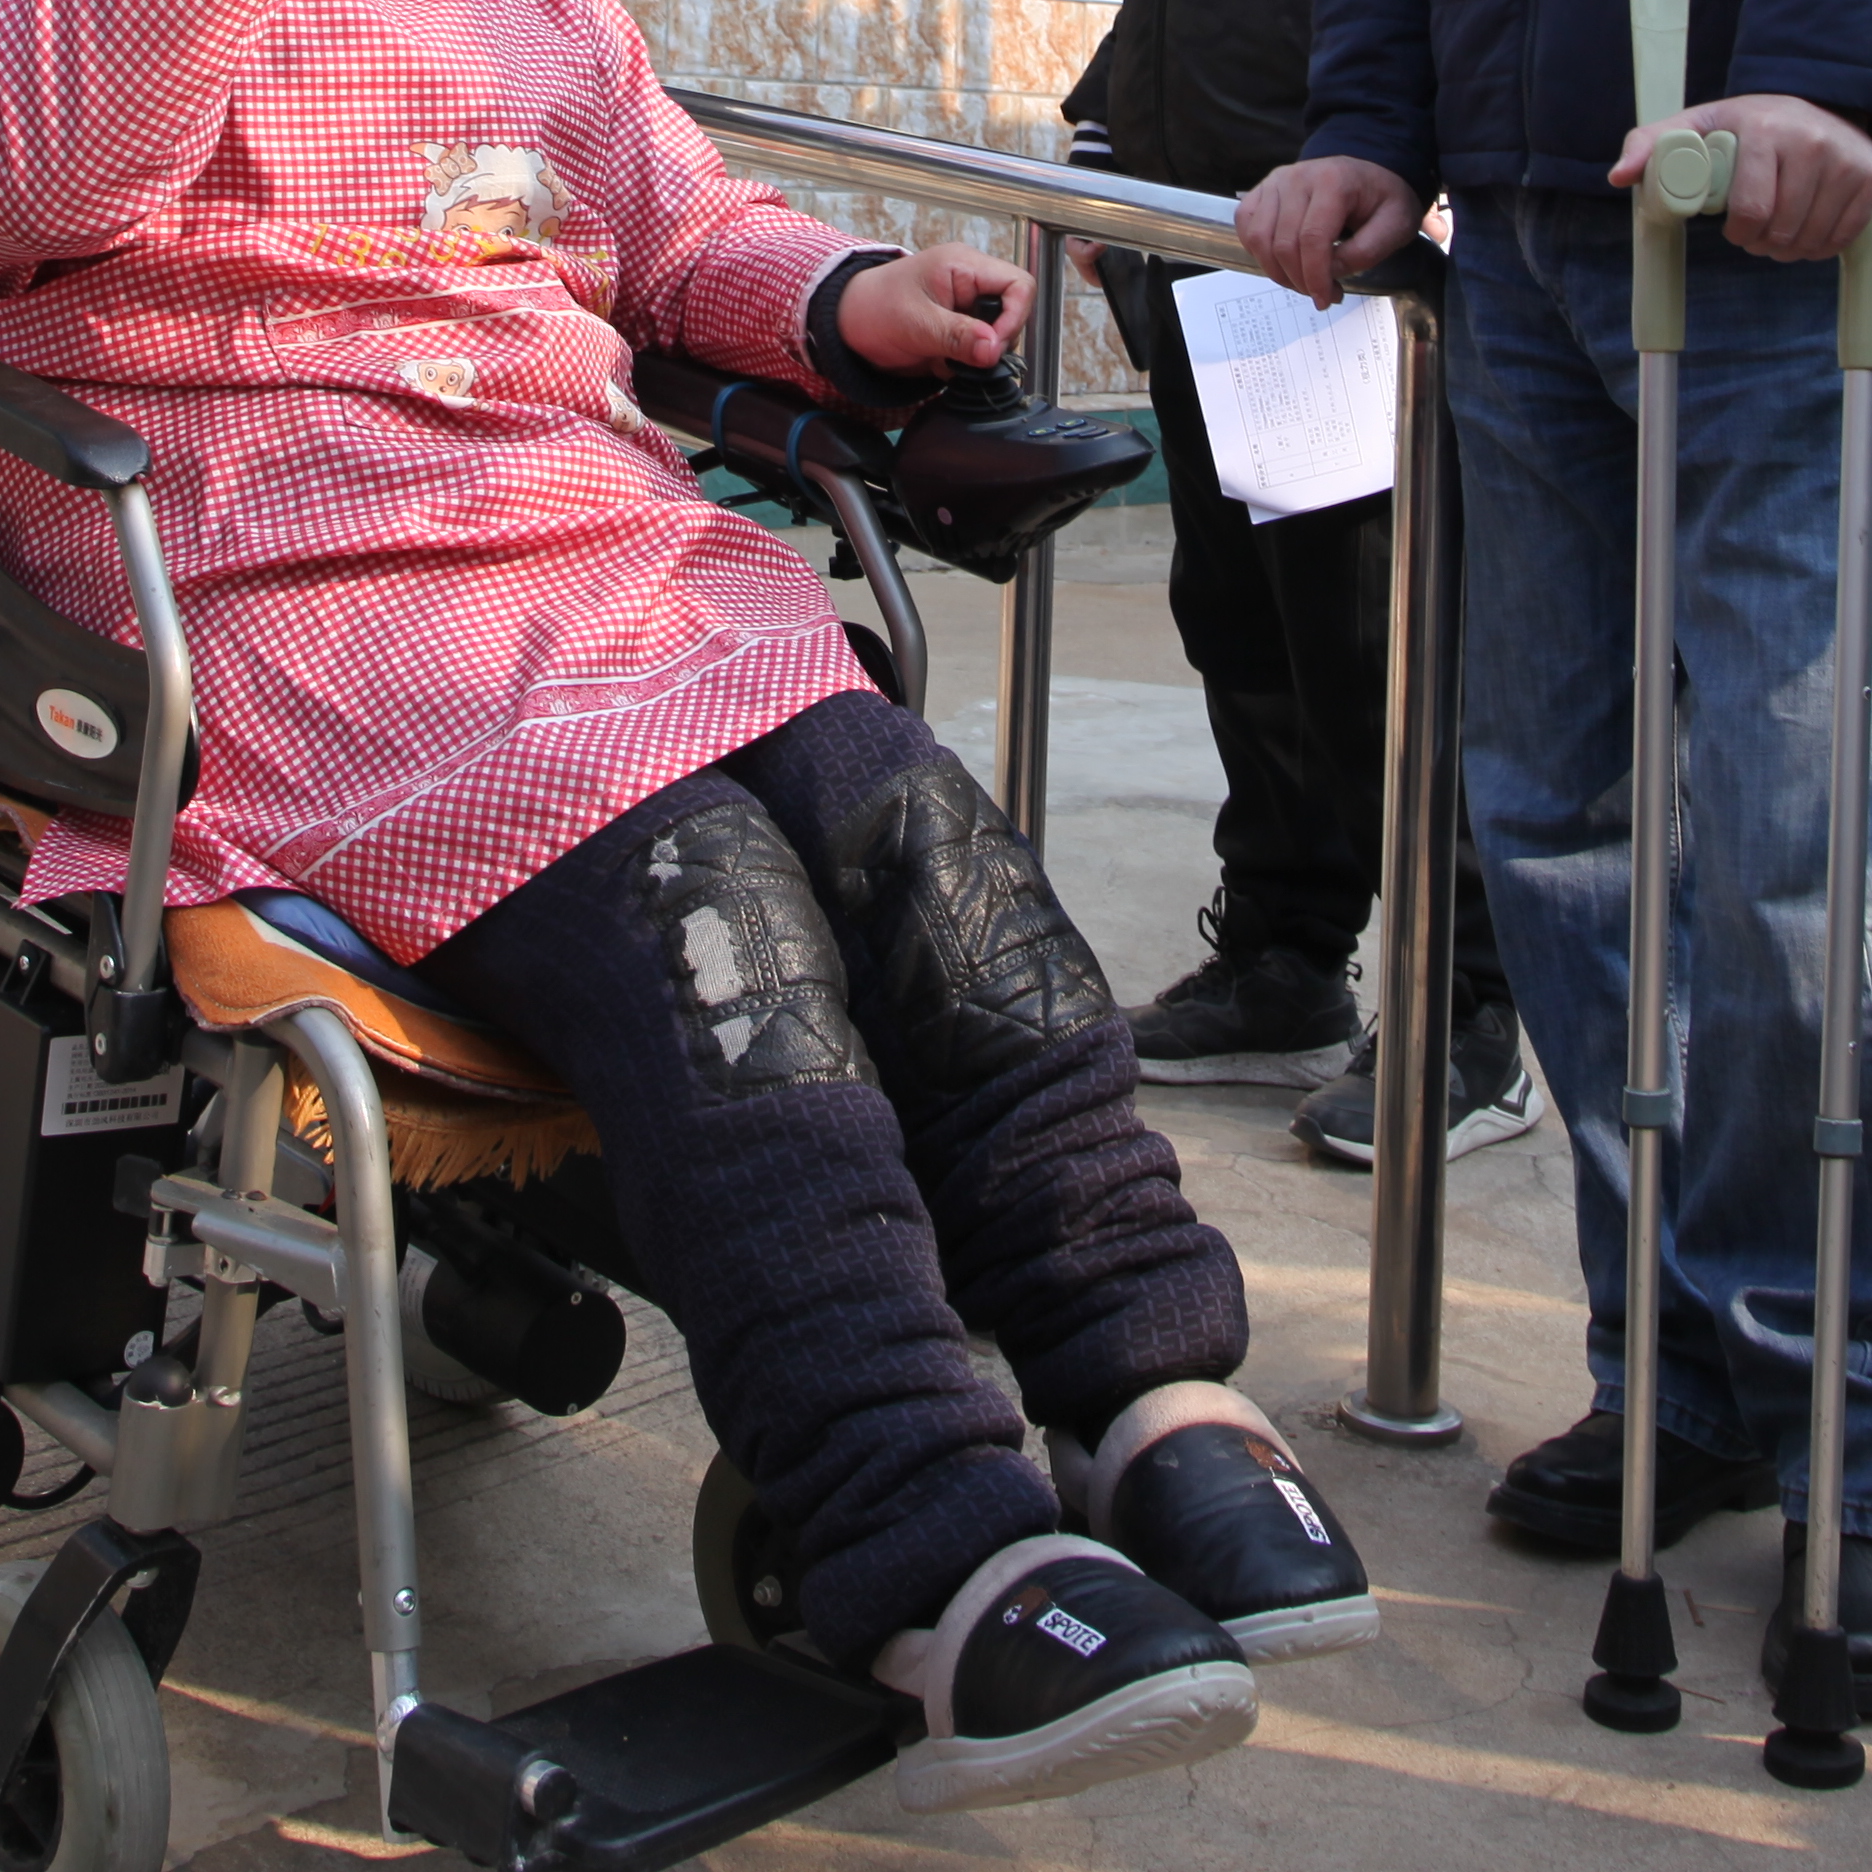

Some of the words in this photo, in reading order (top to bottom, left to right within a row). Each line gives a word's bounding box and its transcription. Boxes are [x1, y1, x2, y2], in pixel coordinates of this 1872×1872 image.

[49, 705, 75, 730] Takan
[1280, 1483, 1328, 1542] SPOTE
[1044, 1612, 1101, 1652] SPOTE
